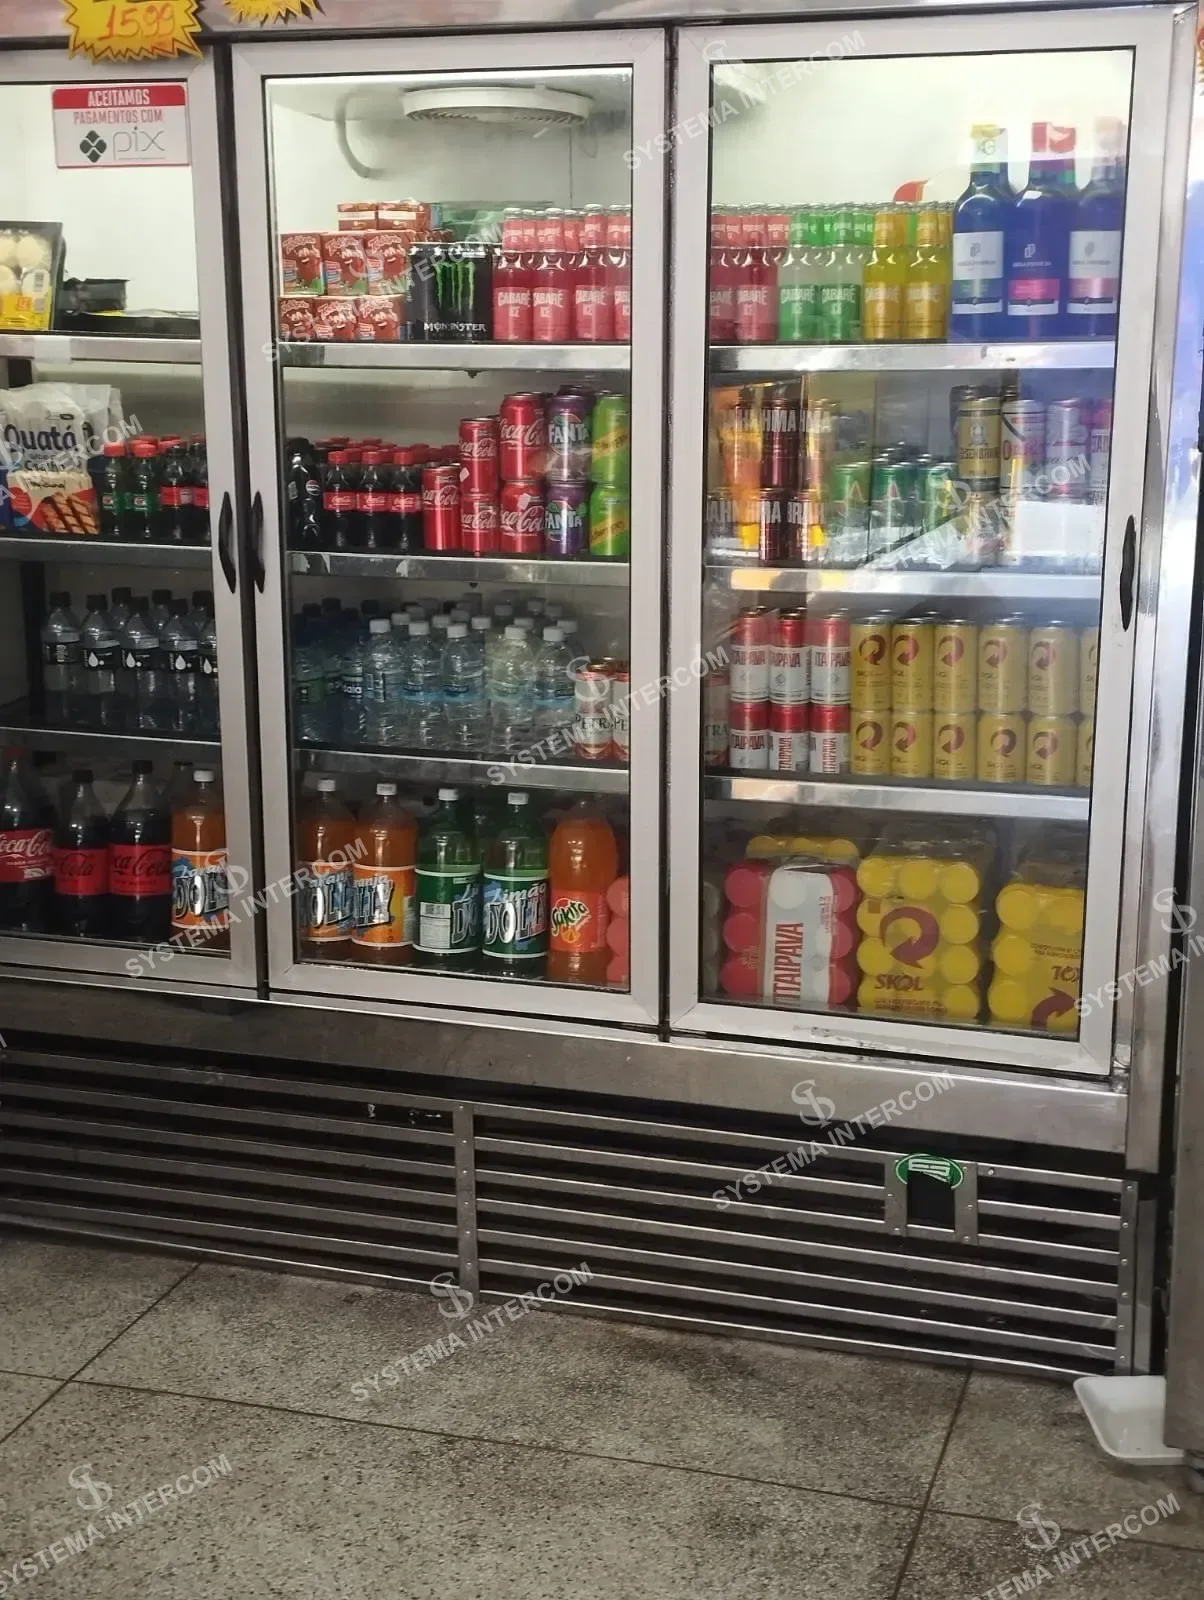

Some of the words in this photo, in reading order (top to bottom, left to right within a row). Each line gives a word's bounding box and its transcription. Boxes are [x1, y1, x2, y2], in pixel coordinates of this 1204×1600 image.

[87, 89, 150, 107] ACEITAMOS
[73, 109, 139, 126] PAGAMENTOS
[141, 108, 163, 123] COM
[112, 126, 166, 160] pix
[548, 423, 589, 443] FANTA
[875, 974, 925, 992] SKOL
